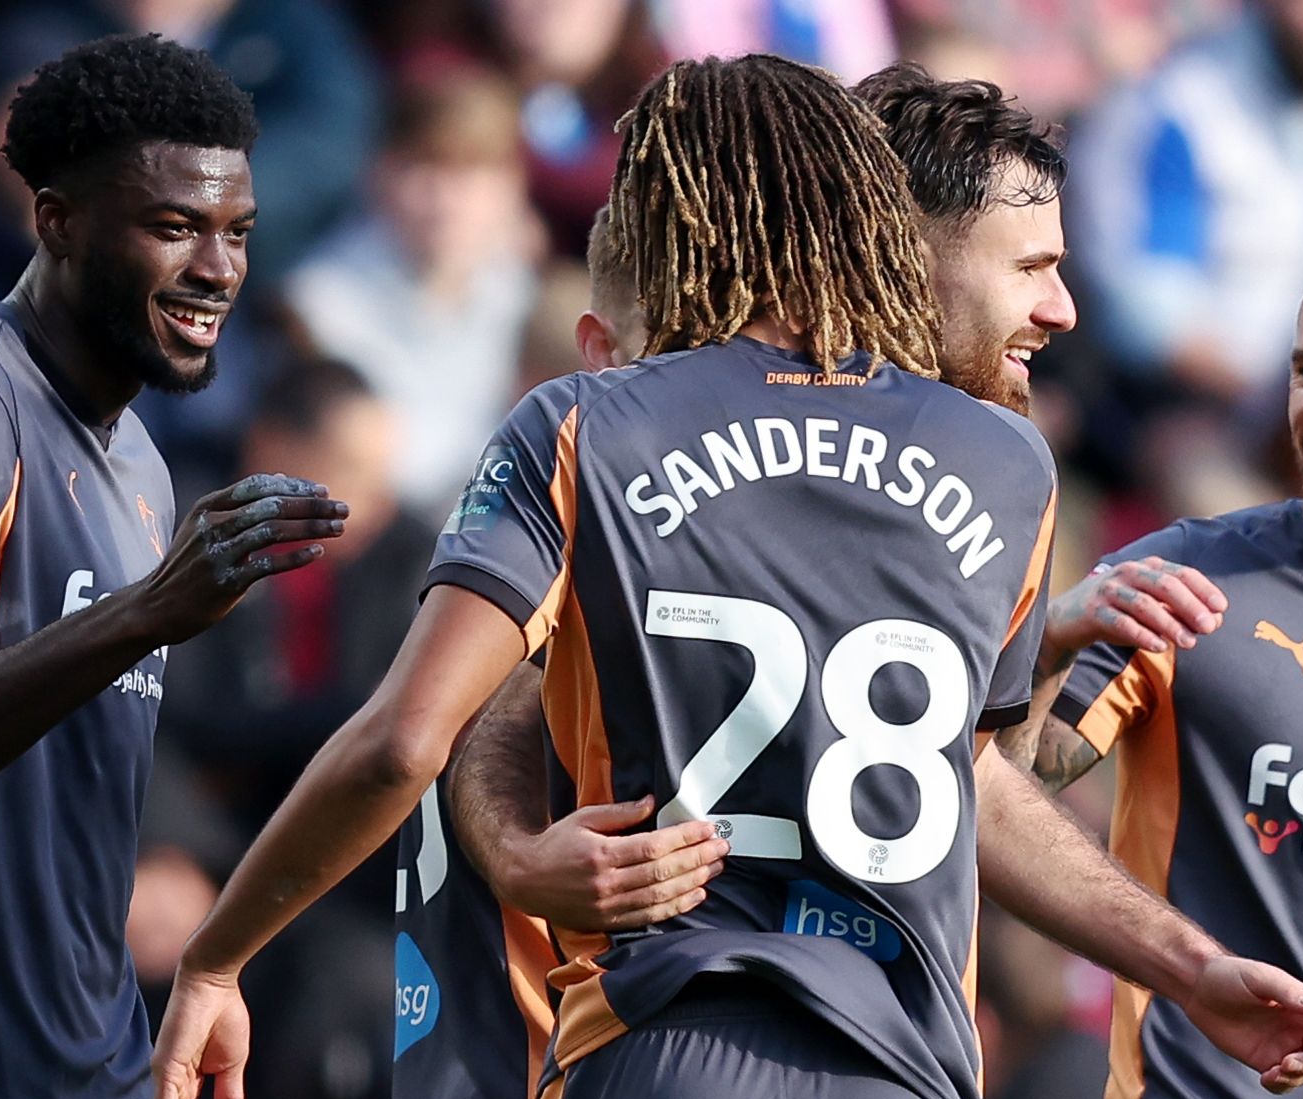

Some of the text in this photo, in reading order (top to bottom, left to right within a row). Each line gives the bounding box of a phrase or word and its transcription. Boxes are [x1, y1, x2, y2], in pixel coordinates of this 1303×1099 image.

[765, 372, 867, 386] DERBY COUNTY
[473, 458, 513, 482] IC
[624, 416, 1006, 581] SANDERSON
[672, 607, 685, 615] EFL
[699, 609, 711, 617] THE
[672, 614, 720, 625] COMMUNITY
[890, 632, 901, 641] EFL
[914, 636, 927, 645] THE
[890, 641, 934, 653] COMMUNITY
[645, 589, 969, 884] 28
[868, 865, 884, 876] EFL
[796, 897, 877, 948] hsg
